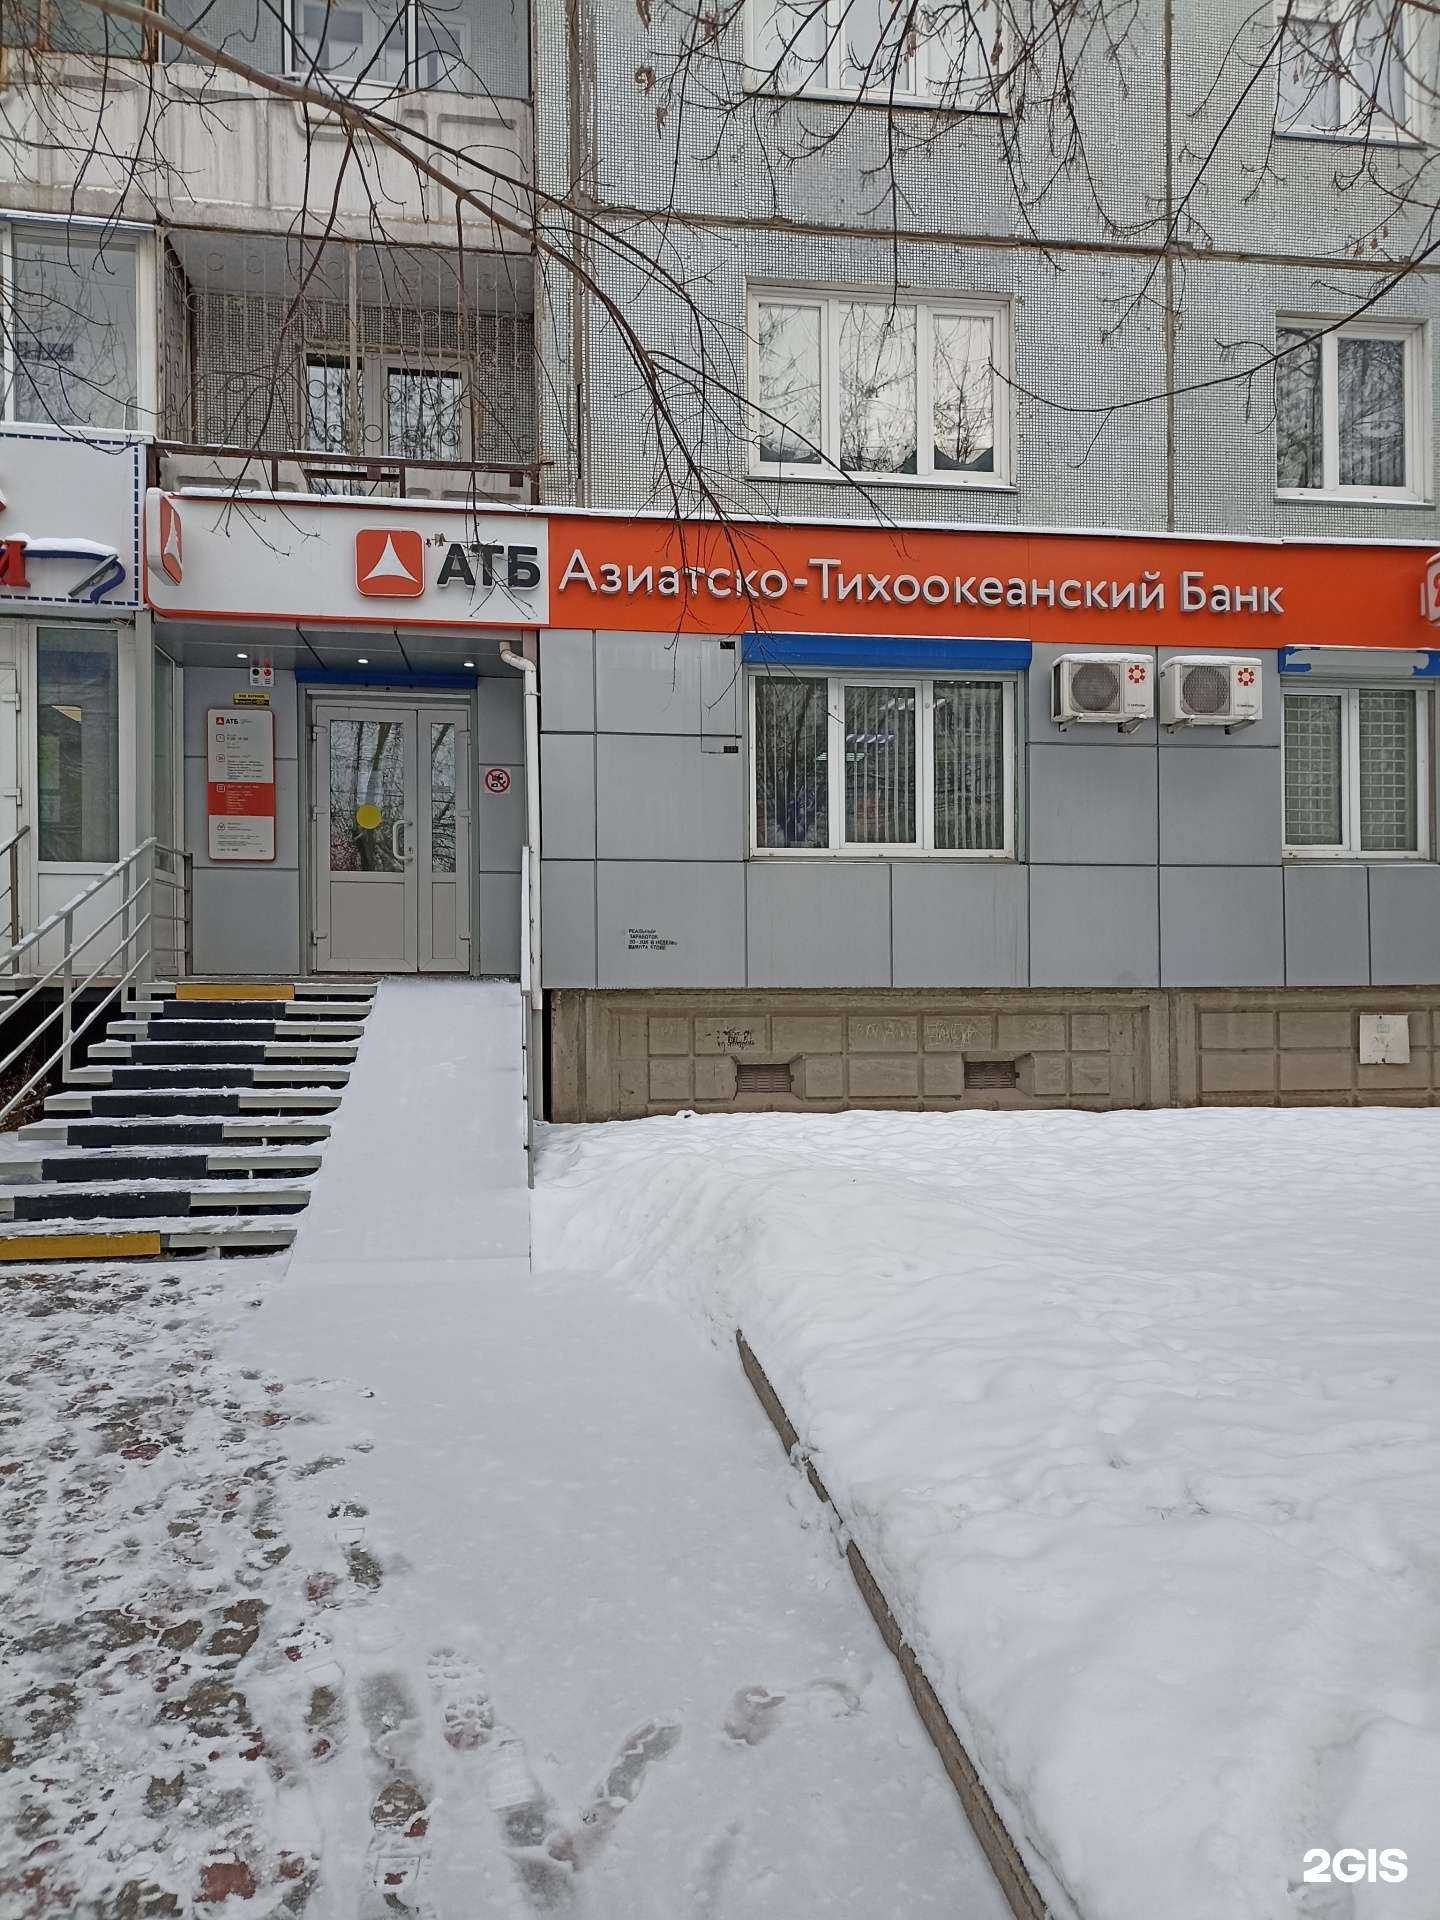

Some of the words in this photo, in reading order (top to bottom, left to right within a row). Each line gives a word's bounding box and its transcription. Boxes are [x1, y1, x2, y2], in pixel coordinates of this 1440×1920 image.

[436, 543, 541, 589] АТБ
[557, 548, 1166, 611] Азиатско-Тихоокеанский
[1179, 570, 1285, 614] Банк
